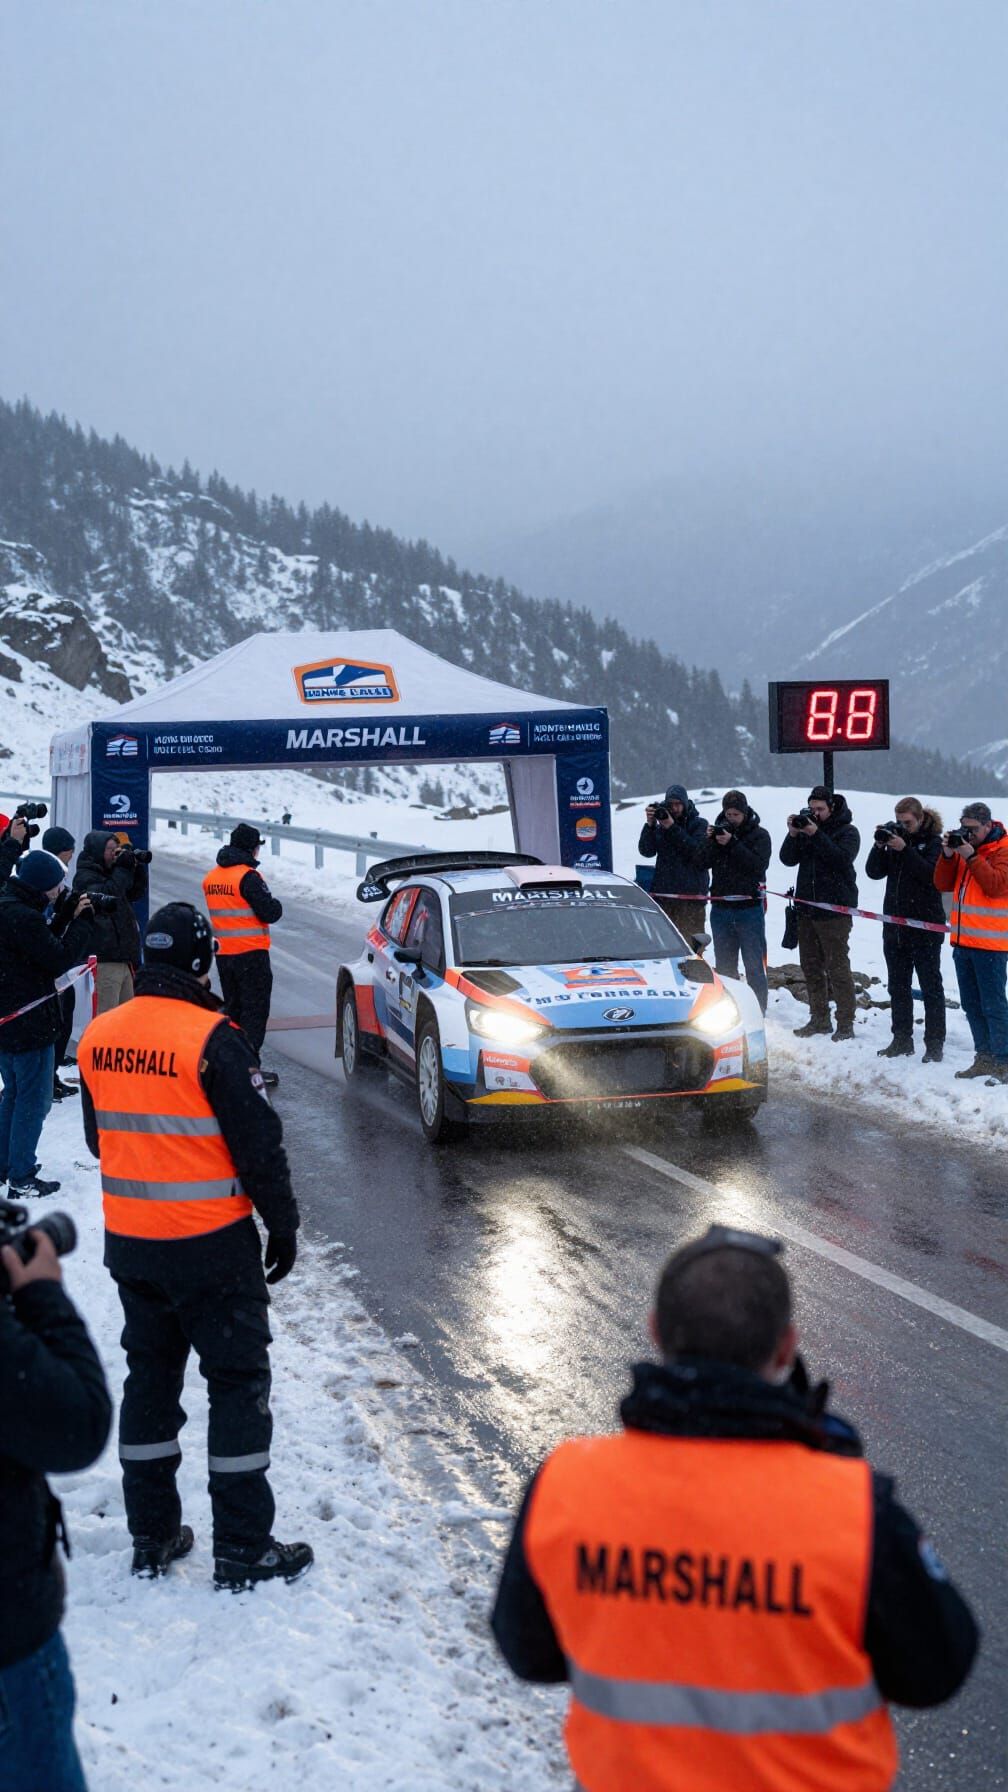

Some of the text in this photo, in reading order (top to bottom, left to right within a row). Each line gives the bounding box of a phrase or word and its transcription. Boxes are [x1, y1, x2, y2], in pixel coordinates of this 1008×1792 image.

[286, 726, 426, 749] MARSHALL
[92, 1047, 178, 1078] MARSHALL
[576, 1543, 813, 1617] MARSHALL
